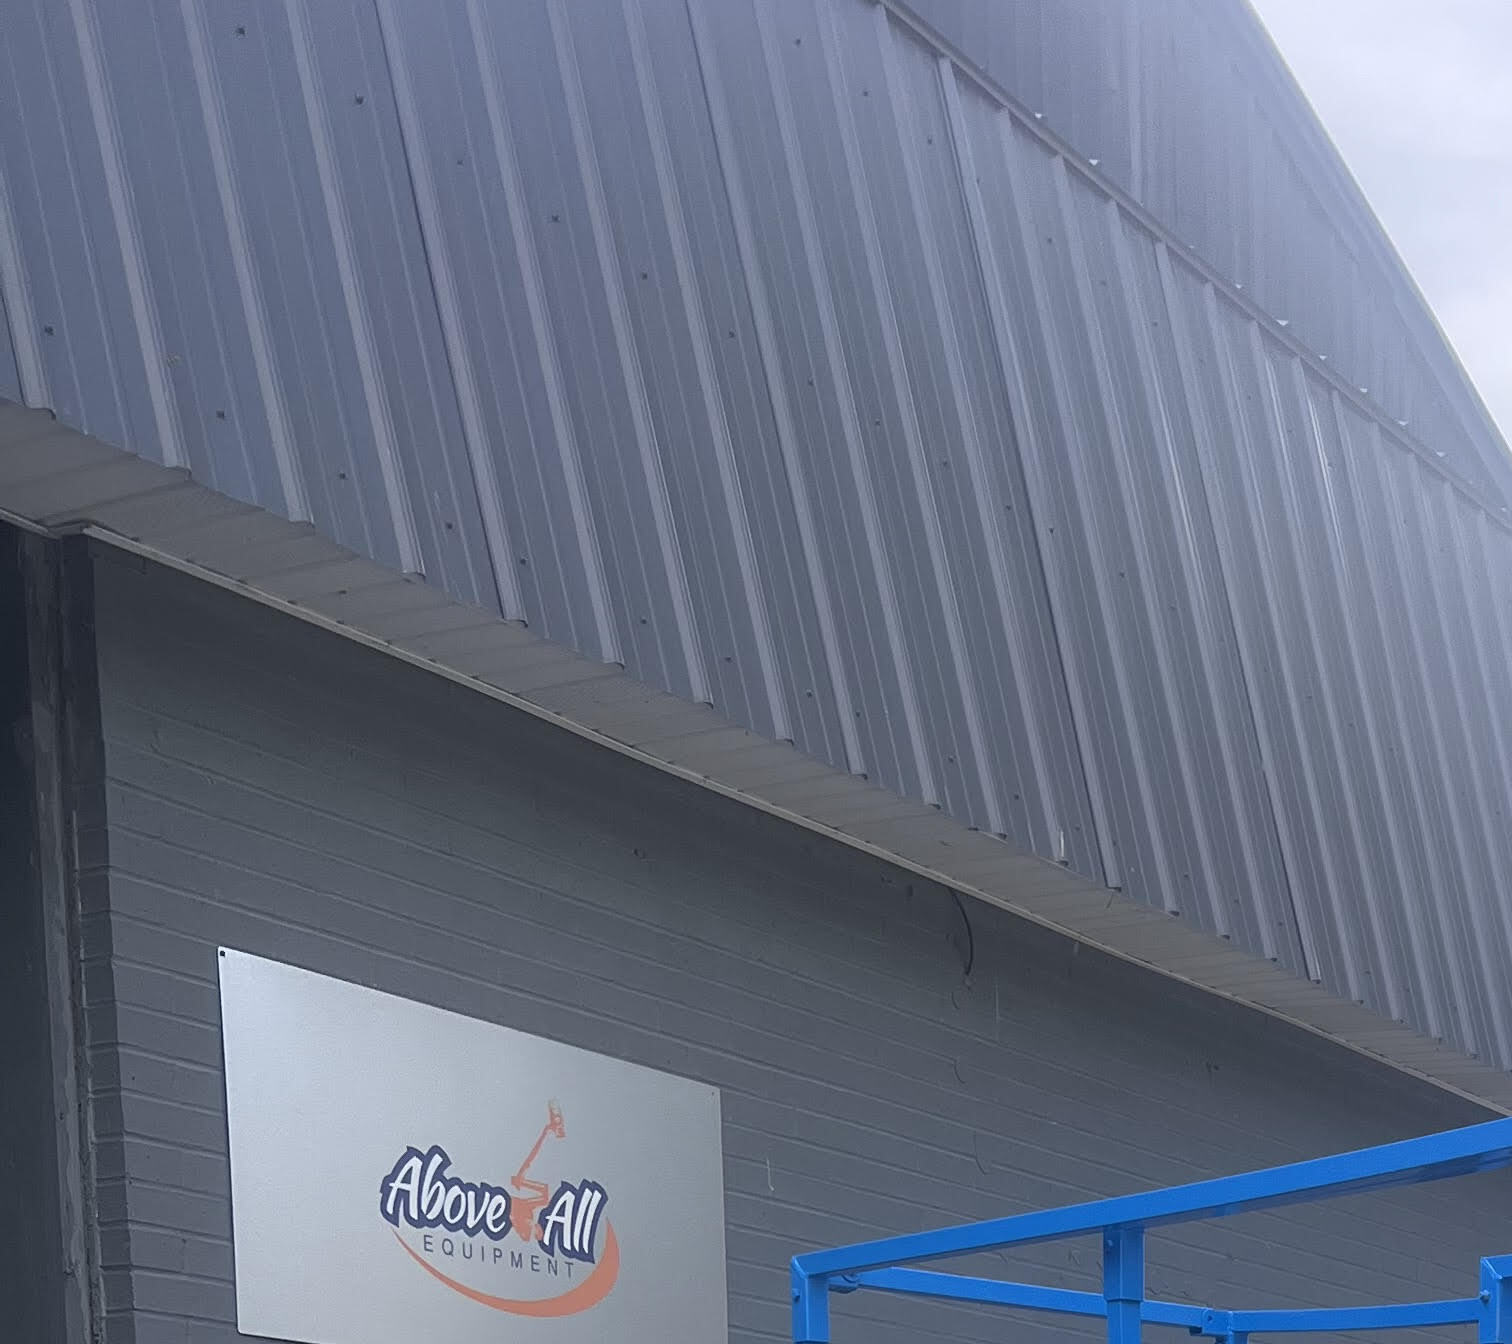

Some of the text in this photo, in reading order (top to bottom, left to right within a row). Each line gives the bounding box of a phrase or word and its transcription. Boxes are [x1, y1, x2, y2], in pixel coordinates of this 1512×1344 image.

[384, 1150, 604, 1258] Above All
[423, 1234, 575, 1278] EQUIPMENT
